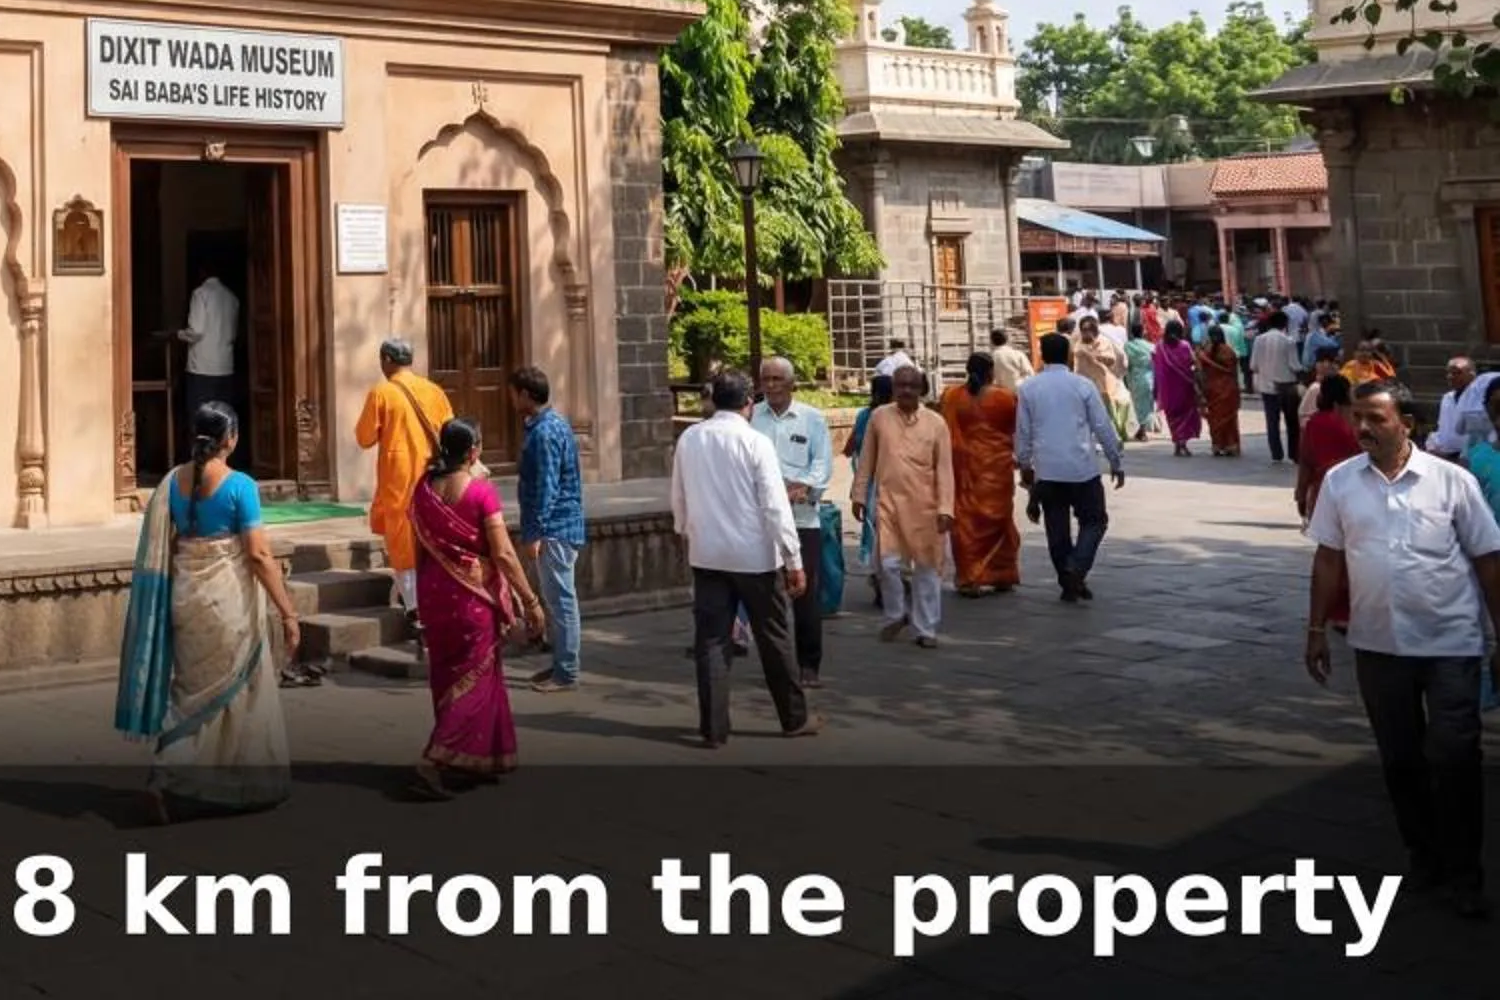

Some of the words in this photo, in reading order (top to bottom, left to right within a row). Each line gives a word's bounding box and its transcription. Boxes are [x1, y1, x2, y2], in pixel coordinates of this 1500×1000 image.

[99, 35, 162, 66] DIXIT
[167, 39, 235, 71] WADA
[241, 44, 334, 78] MUSEUM
[109, 78, 139, 101] SAI
[145, 80, 209, 105] BABA'S
[213, 84, 250, 107] LIFE
[255, 87, 327, 111] HISTORY
